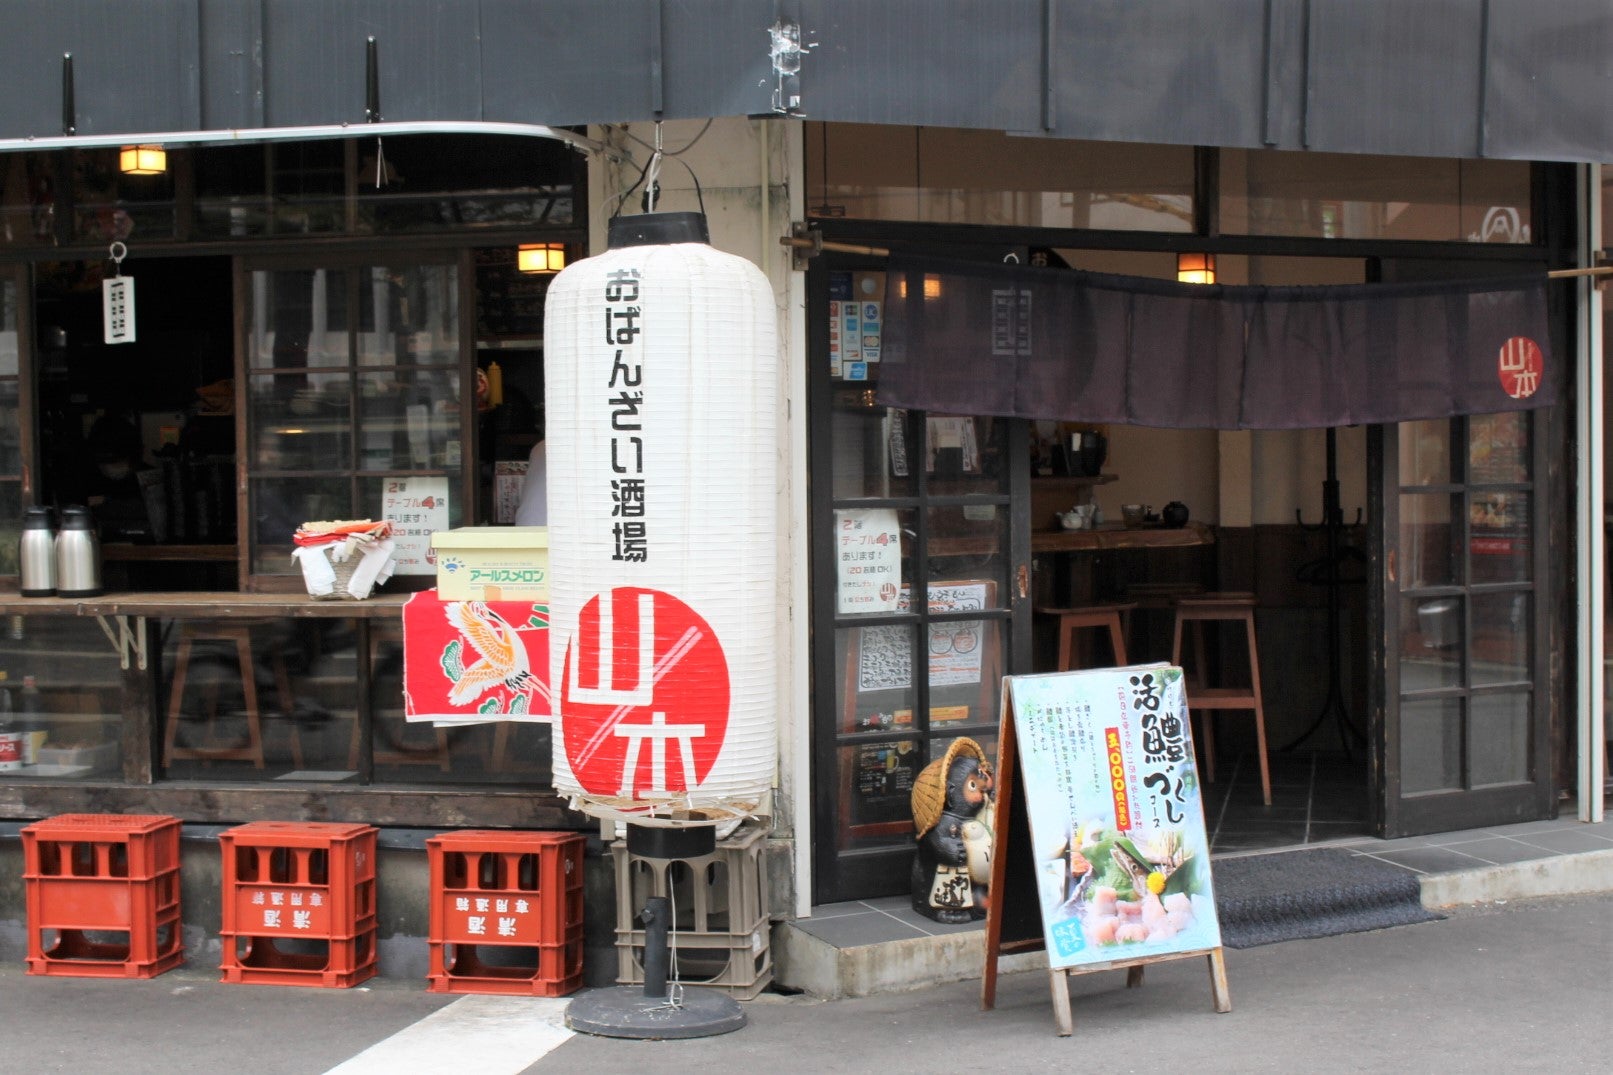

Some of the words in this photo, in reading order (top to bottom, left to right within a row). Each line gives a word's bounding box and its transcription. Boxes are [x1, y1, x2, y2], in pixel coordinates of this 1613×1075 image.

[605, 268, 647, 562] おばんざい酒場
[387, 495, 445, 509] テーブル4席
[842, 533, 897, 546] テーブル4席
[470, 569, 545, 582] アールスメロン
[455, 897, 529, 914] 専用通箱
[263, 910, 312, 929] 清酒
[467, 916, 517, 937] 清酒
